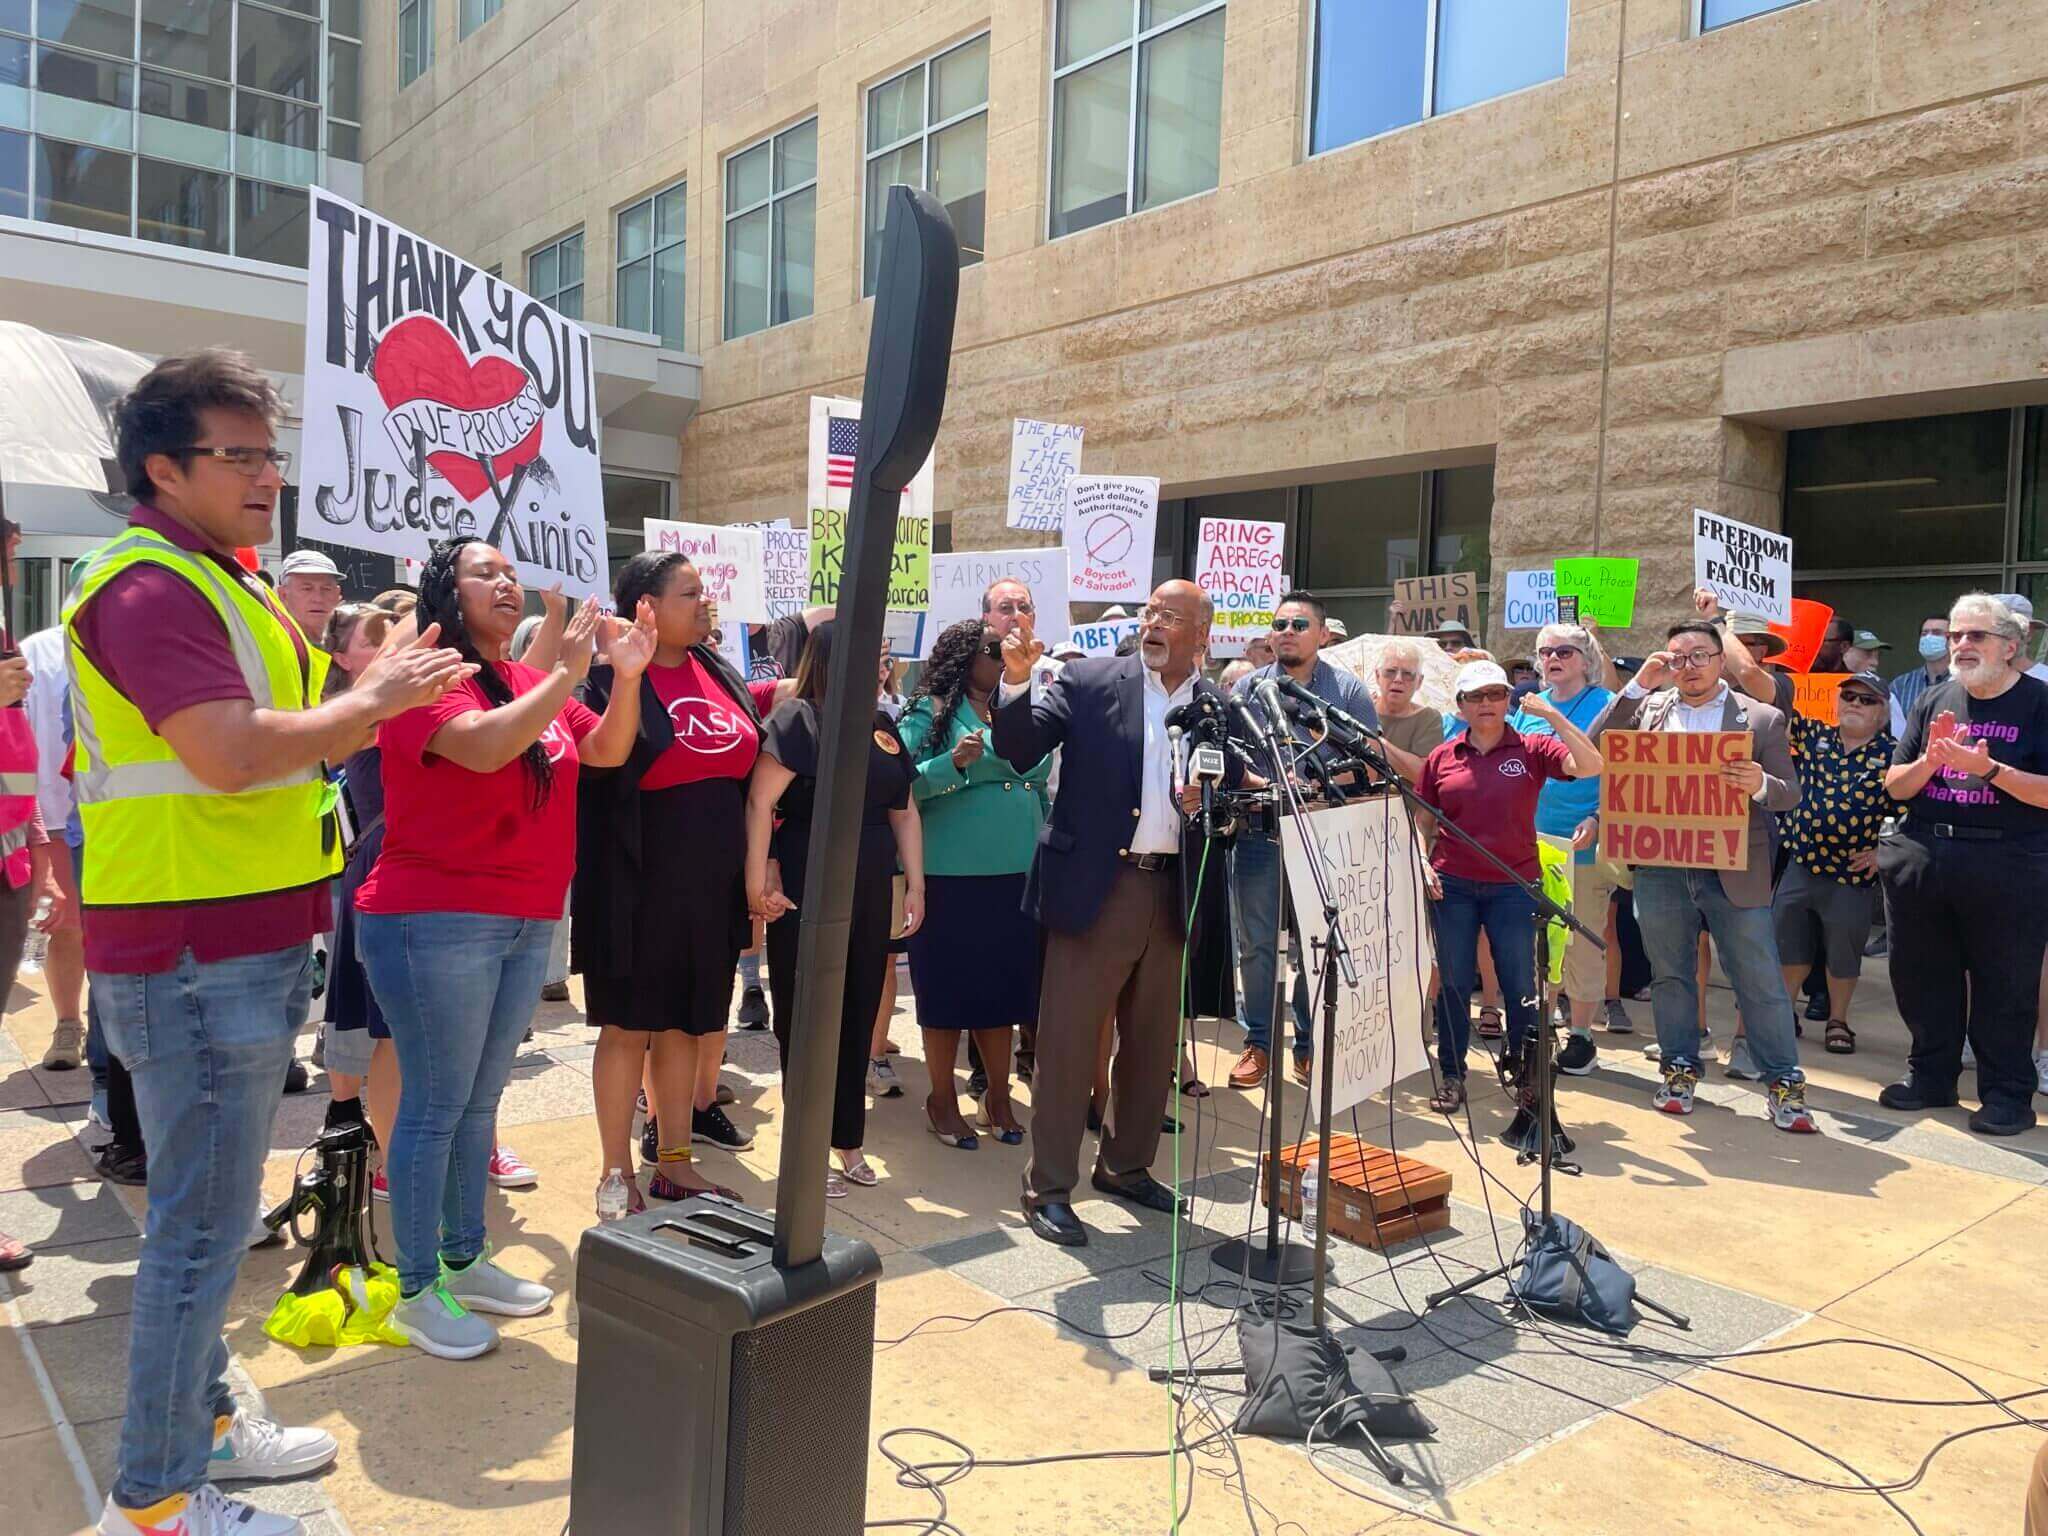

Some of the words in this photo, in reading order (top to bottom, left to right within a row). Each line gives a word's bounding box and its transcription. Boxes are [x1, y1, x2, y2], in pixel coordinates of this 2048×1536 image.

[316, 197, 481, 374] THANK
[482, 276, 597, 456] YOU
[392, 402, 455, 450] DUE
[459, 384, 544, 453] PROCESS
[1017, 420, 1046, 436] THE
[1053, 424, 1084, 441] LAW
[1042, 438, 1060, 450] OF
[1019, 461, 1075, 475] LAND
[1029, 449, 1072, 465] THE
[315, 404, 478, 548] Judge
[474, 452, 599, 584] Xinis
[1073, 493, 1104, 507] tourist
[1107, 493, 1137, 504] dollars
[1140, 500, 1149, 509] to
[1076, 483, 1100, 495] Don't
[1103, 482, 1122, 491] give
[1124, 484, 1144, 496] your
[1078, 503, 1143, 518] Authoritarians
[660, 529, 717, 557] Moral
[767, 531, 807, 550] PROCE
[1203, 521, 1275, 545] BRING
[1698, 516, 1789, 563] FREEDOM
[1210, 545, 1281, 569] ABREGO
[1725, 544, 1763, 573] NOT
[1072, 575, 1084, 586] El
[1086, 577, 1136, 592] Salvador!
[1084, 567, 1127, 580] Boycott
[1198, 571, 1274, 595] GARCIA
[1563, 571, 1592, 586] Due
[1706, 559, 1775, 598] FACISM
[1398, 574, 1469, 600] THIS
[1211, 593, 1271, 609] HOME
[1508, 600, 1556, 625] COUR
[1229, 611, 1274, 628] PROCES
[1397, 606, 1446, 632] WAS
[1457, 604, 1469, 629] A
[1073, 625, 1121, 650] OBEY
[1953, 720, 2019, 743] isting
[1608, 733, 1746, 764] BRING
[1608, 773, 1745, 816] KILMAR
[1927, 785, 2000, 805] haraoh.
[1322, 816, 1400, 870] KILMAR
[1607, 823, 1741, 866] HOME!
[1344, 903, 1392, 941] ARCIA
[1352, 976, 1387, 1020] DUE
